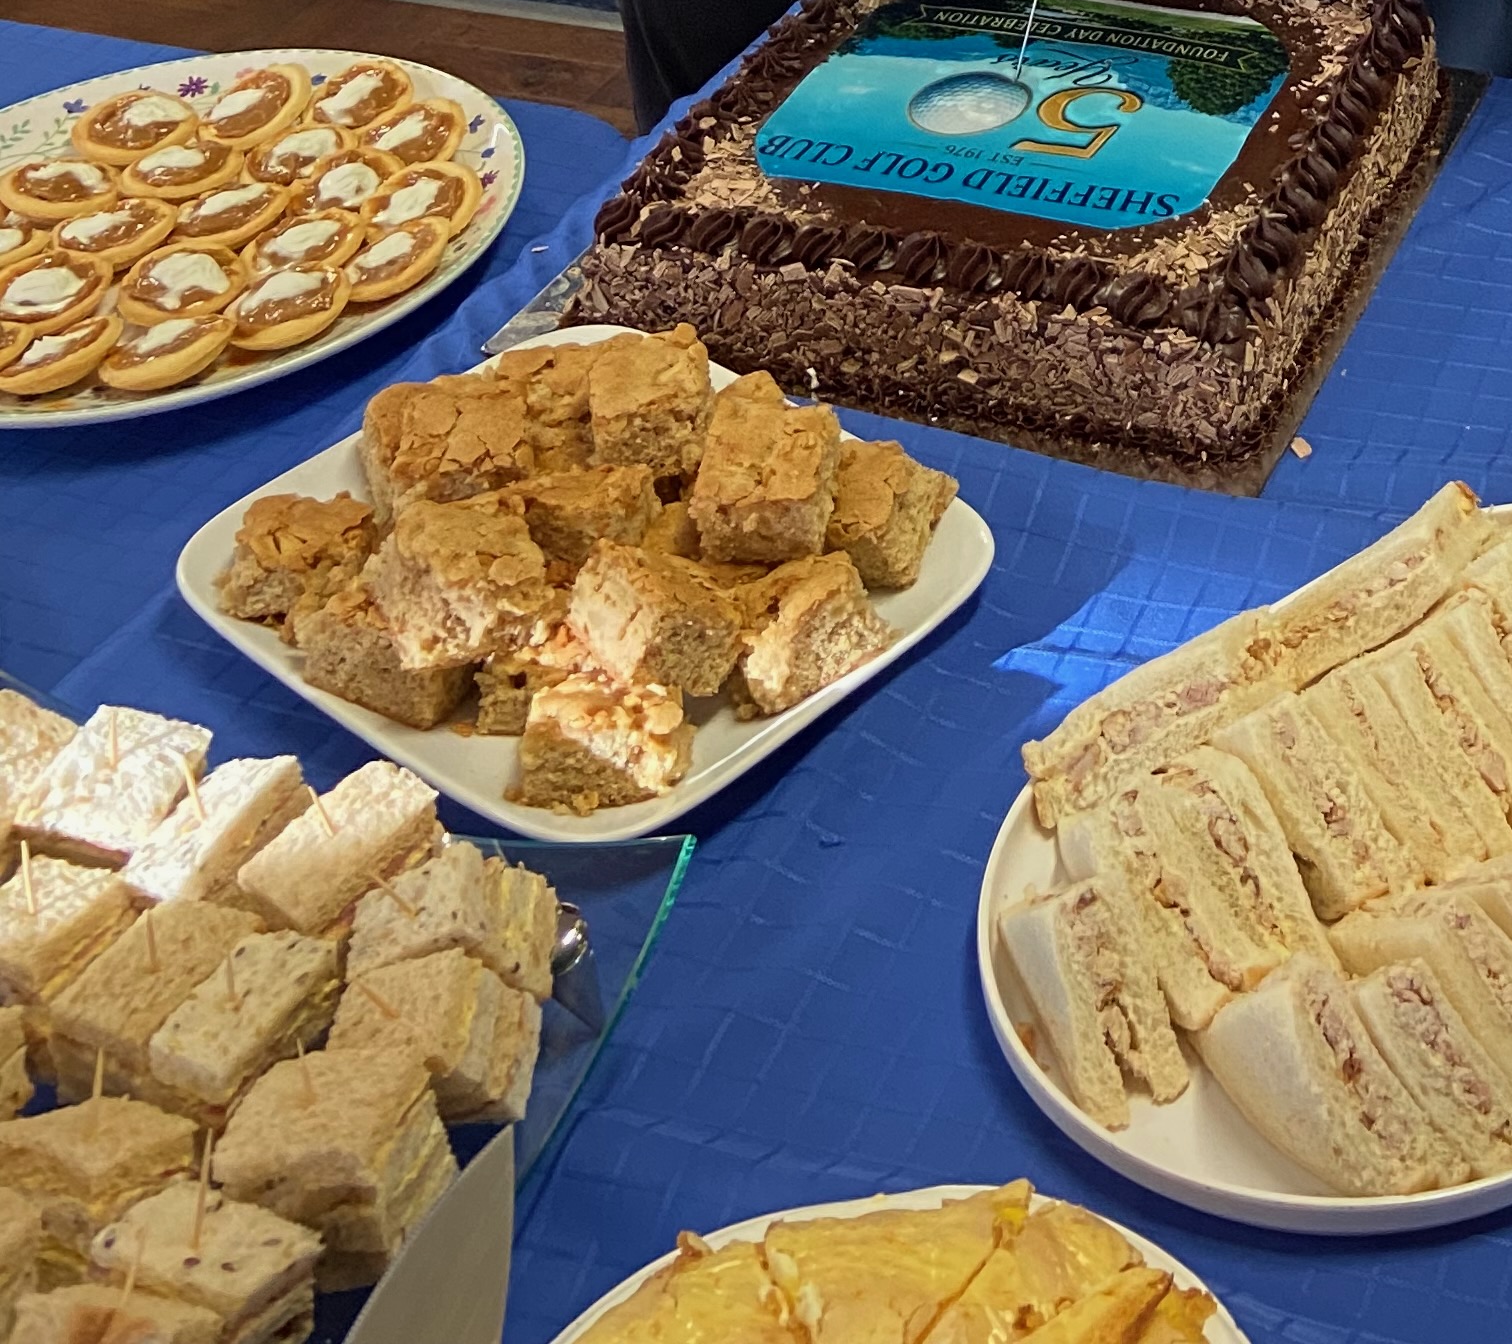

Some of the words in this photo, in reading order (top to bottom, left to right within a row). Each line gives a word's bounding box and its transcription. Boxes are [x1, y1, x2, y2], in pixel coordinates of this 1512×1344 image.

[934, 11, 1063, 37] CELEBRATION
[1065, 28, 1105, 42] DAY
[1106, 32, 1230, 62] FOUNDATION
[758, 135, 854, 166] CLUB
[944, 144, 984, 160] 1976
[988, 151, 1025, 167] EST
[853, 150, 955, 184] GOLF
[962, 167, 1181, 217] SHEFFIELD
